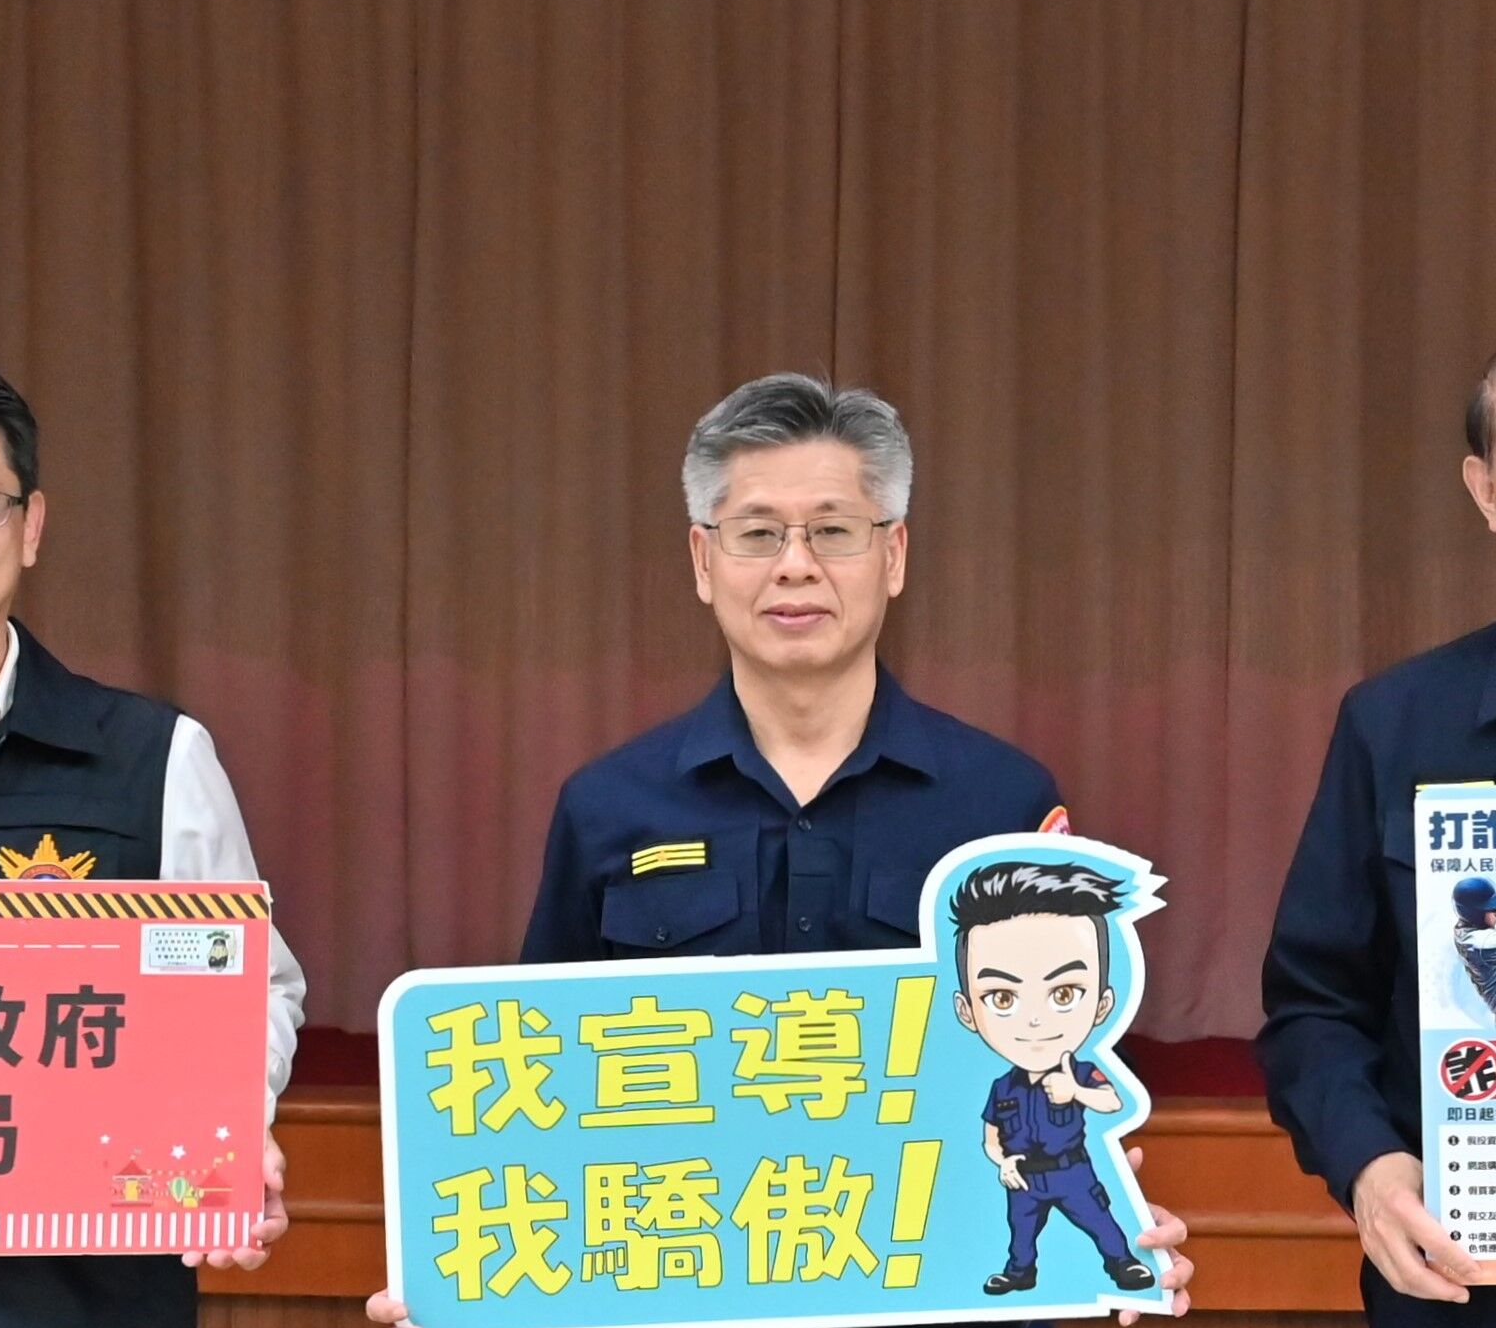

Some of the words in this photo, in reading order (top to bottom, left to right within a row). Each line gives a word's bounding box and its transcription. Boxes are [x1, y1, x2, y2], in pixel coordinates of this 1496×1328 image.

[426, 975, 936, 1136] 我宣導!
[432, 1140, 942, 1302] 我驕傲!
